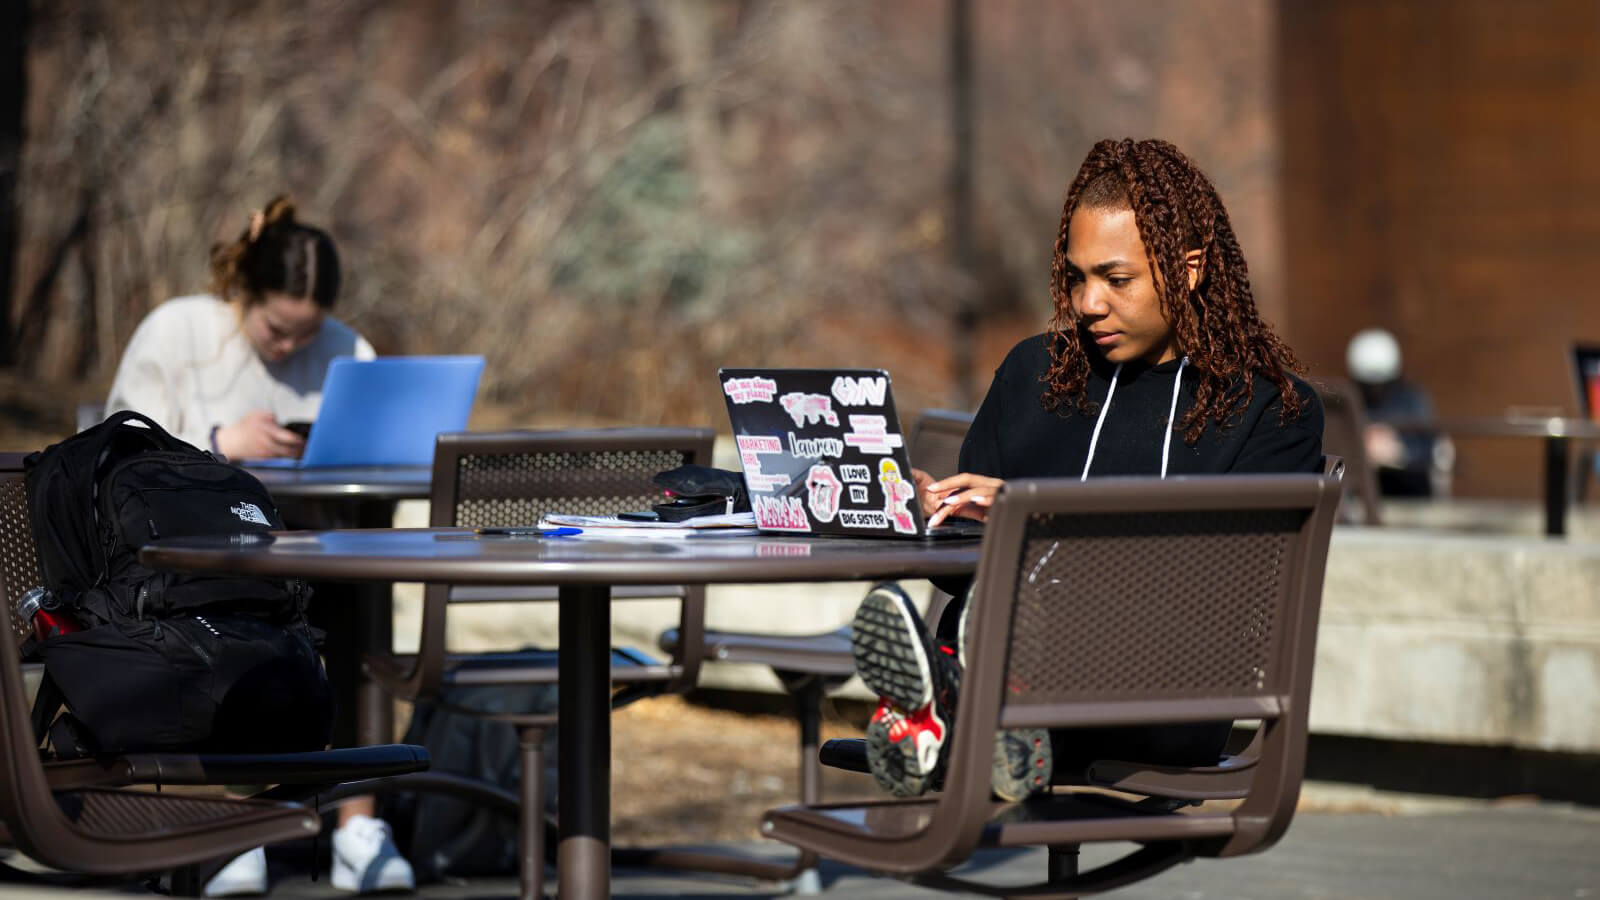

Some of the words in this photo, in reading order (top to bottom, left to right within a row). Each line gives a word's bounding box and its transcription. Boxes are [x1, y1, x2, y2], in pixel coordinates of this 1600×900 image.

[738, 439, 781, 451] MARKETING
[789, 433, 842, 457] Lauren
[240, 501, 255, 511] THE
[842, 512, 856, 524] BIG
